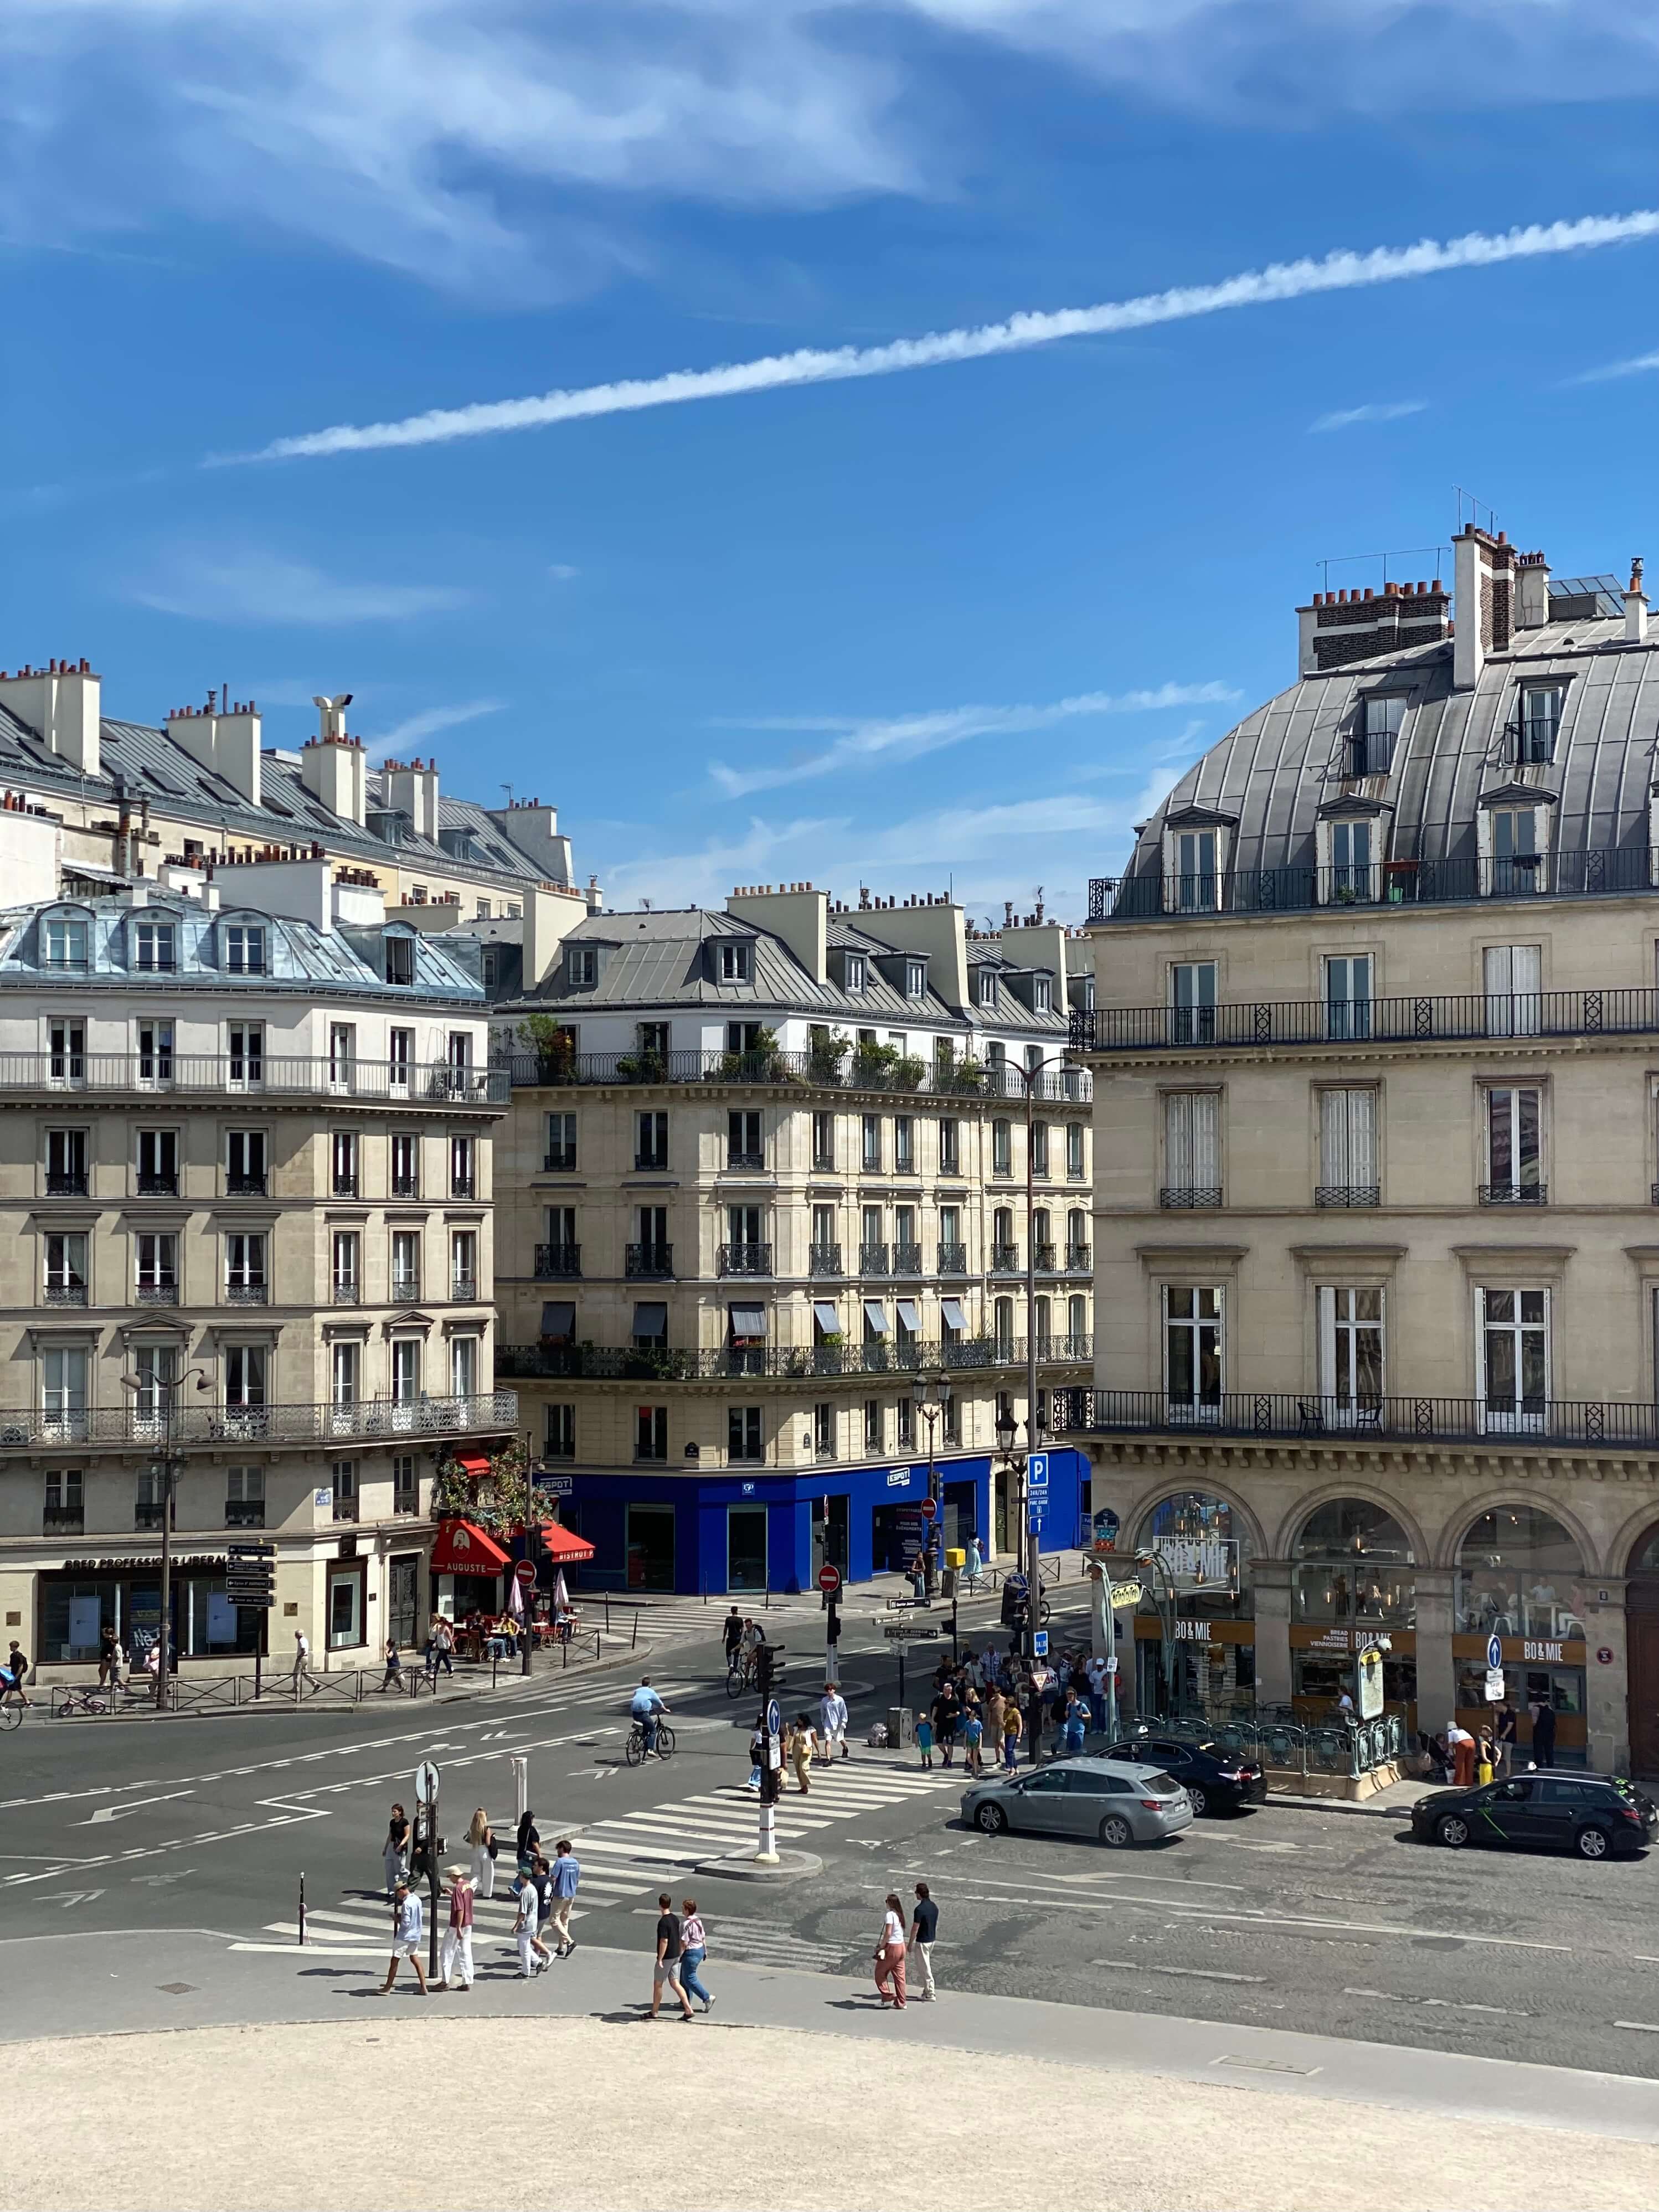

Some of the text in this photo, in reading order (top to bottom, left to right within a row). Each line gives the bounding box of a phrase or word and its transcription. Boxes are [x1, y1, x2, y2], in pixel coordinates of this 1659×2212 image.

[1034, 1461, 1043, 1481] P
[890, 1471, 908, 1482] ESPOT
[65, 1560, 96, 1569] BRED
[447, 1563, 486, 1572] AUGUSTE
